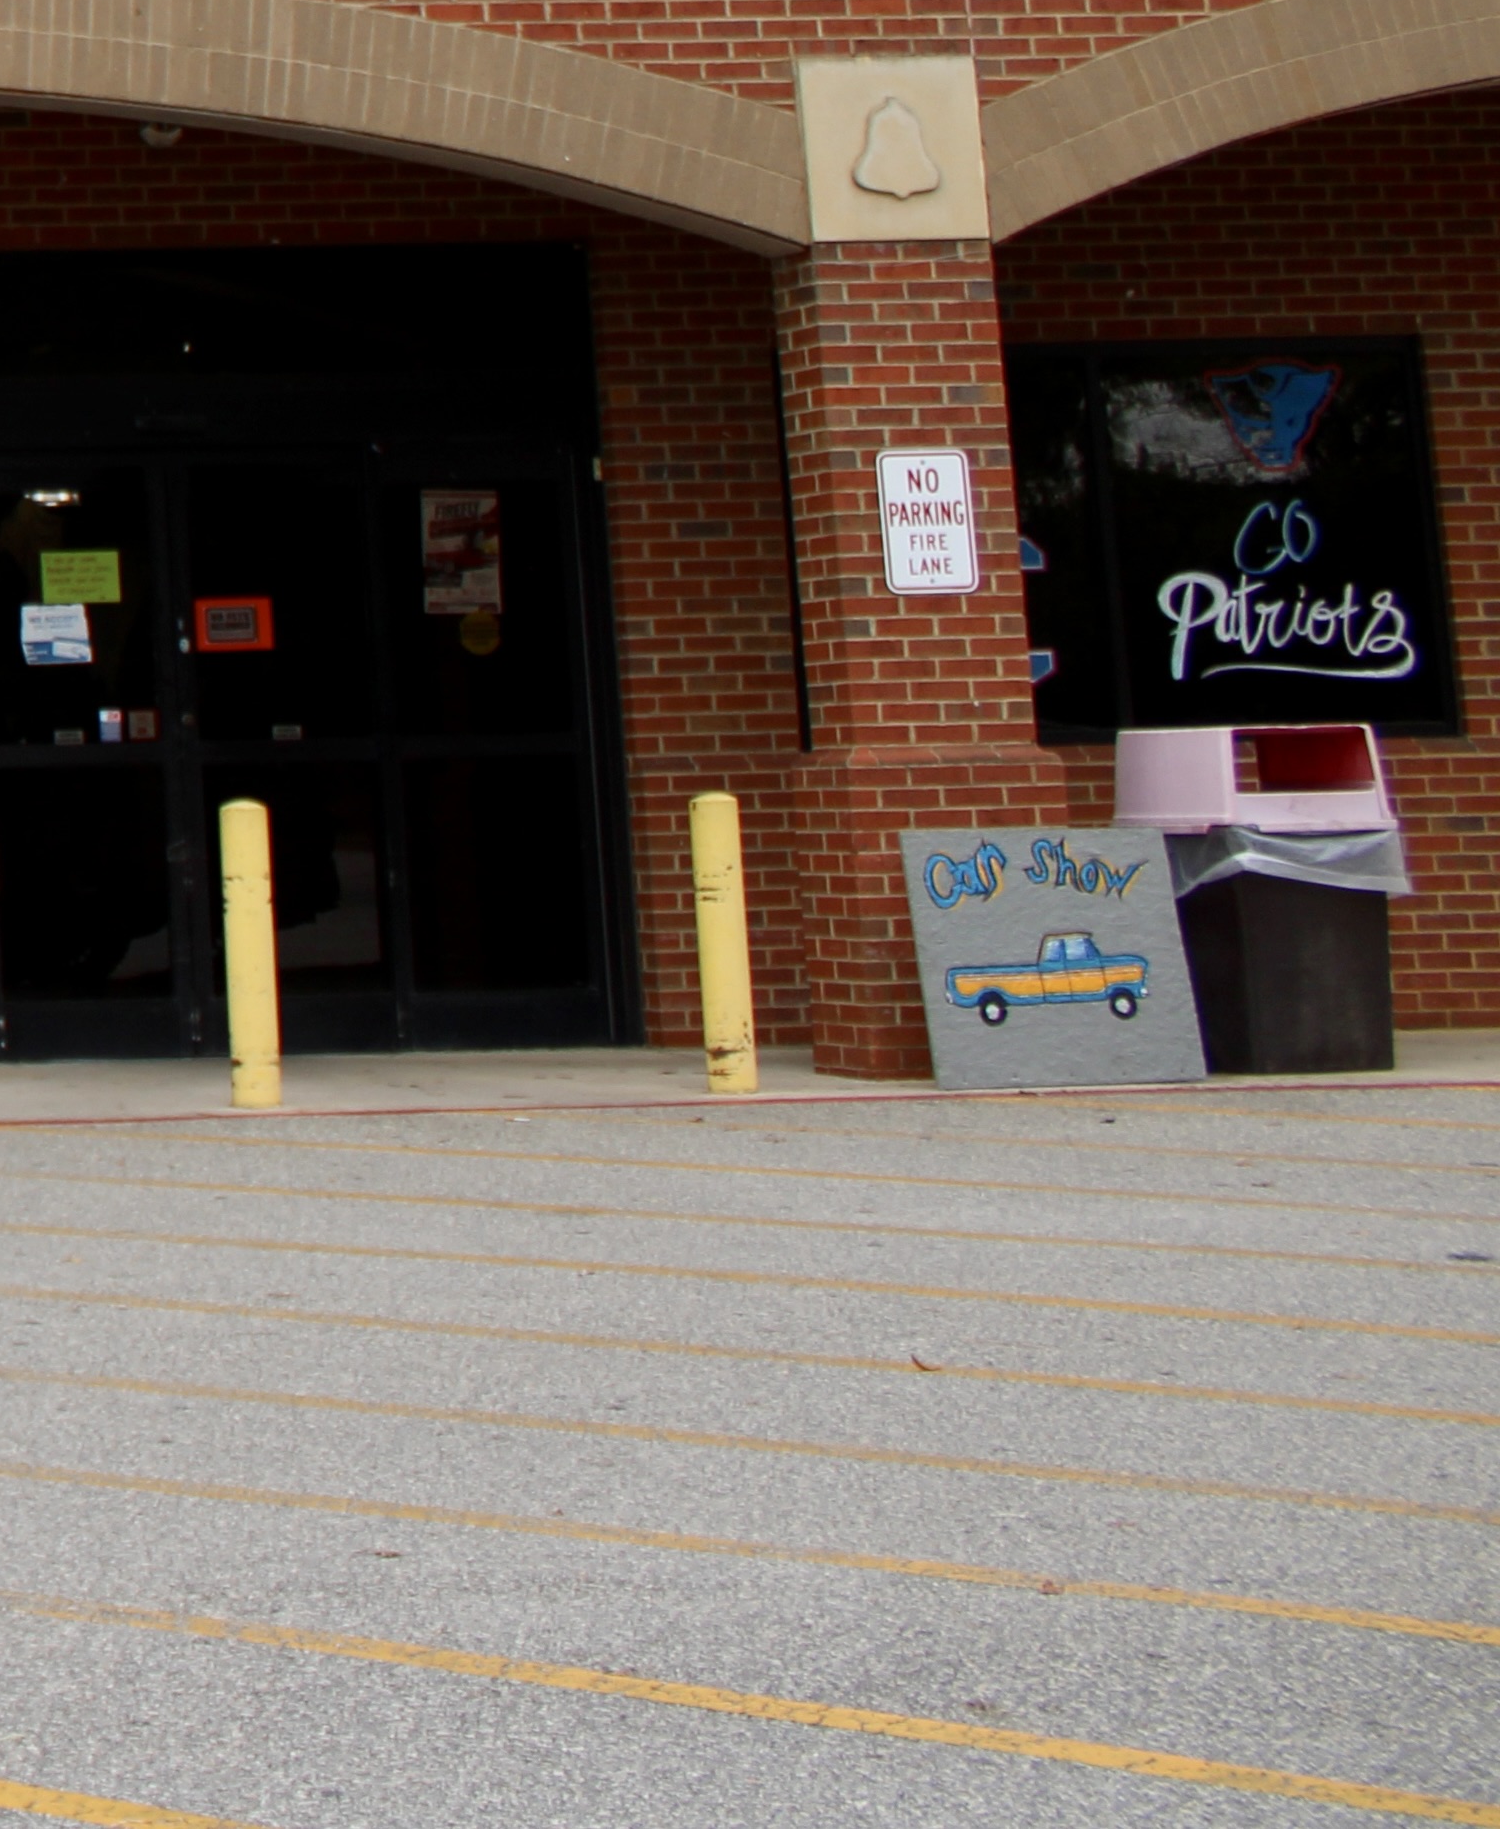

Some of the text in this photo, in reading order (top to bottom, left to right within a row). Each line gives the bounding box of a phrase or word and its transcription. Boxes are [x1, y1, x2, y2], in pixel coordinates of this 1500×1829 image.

[907, 467, 940, 494] NO
[887, 499, 965, 528] PARKING
[909, 533, 949, 552] FIRE
[908, 557, 954, 576] LANE
[1157, 572, 1415, 680] Patriots
[923, 836, 1150, 911] Car Show
